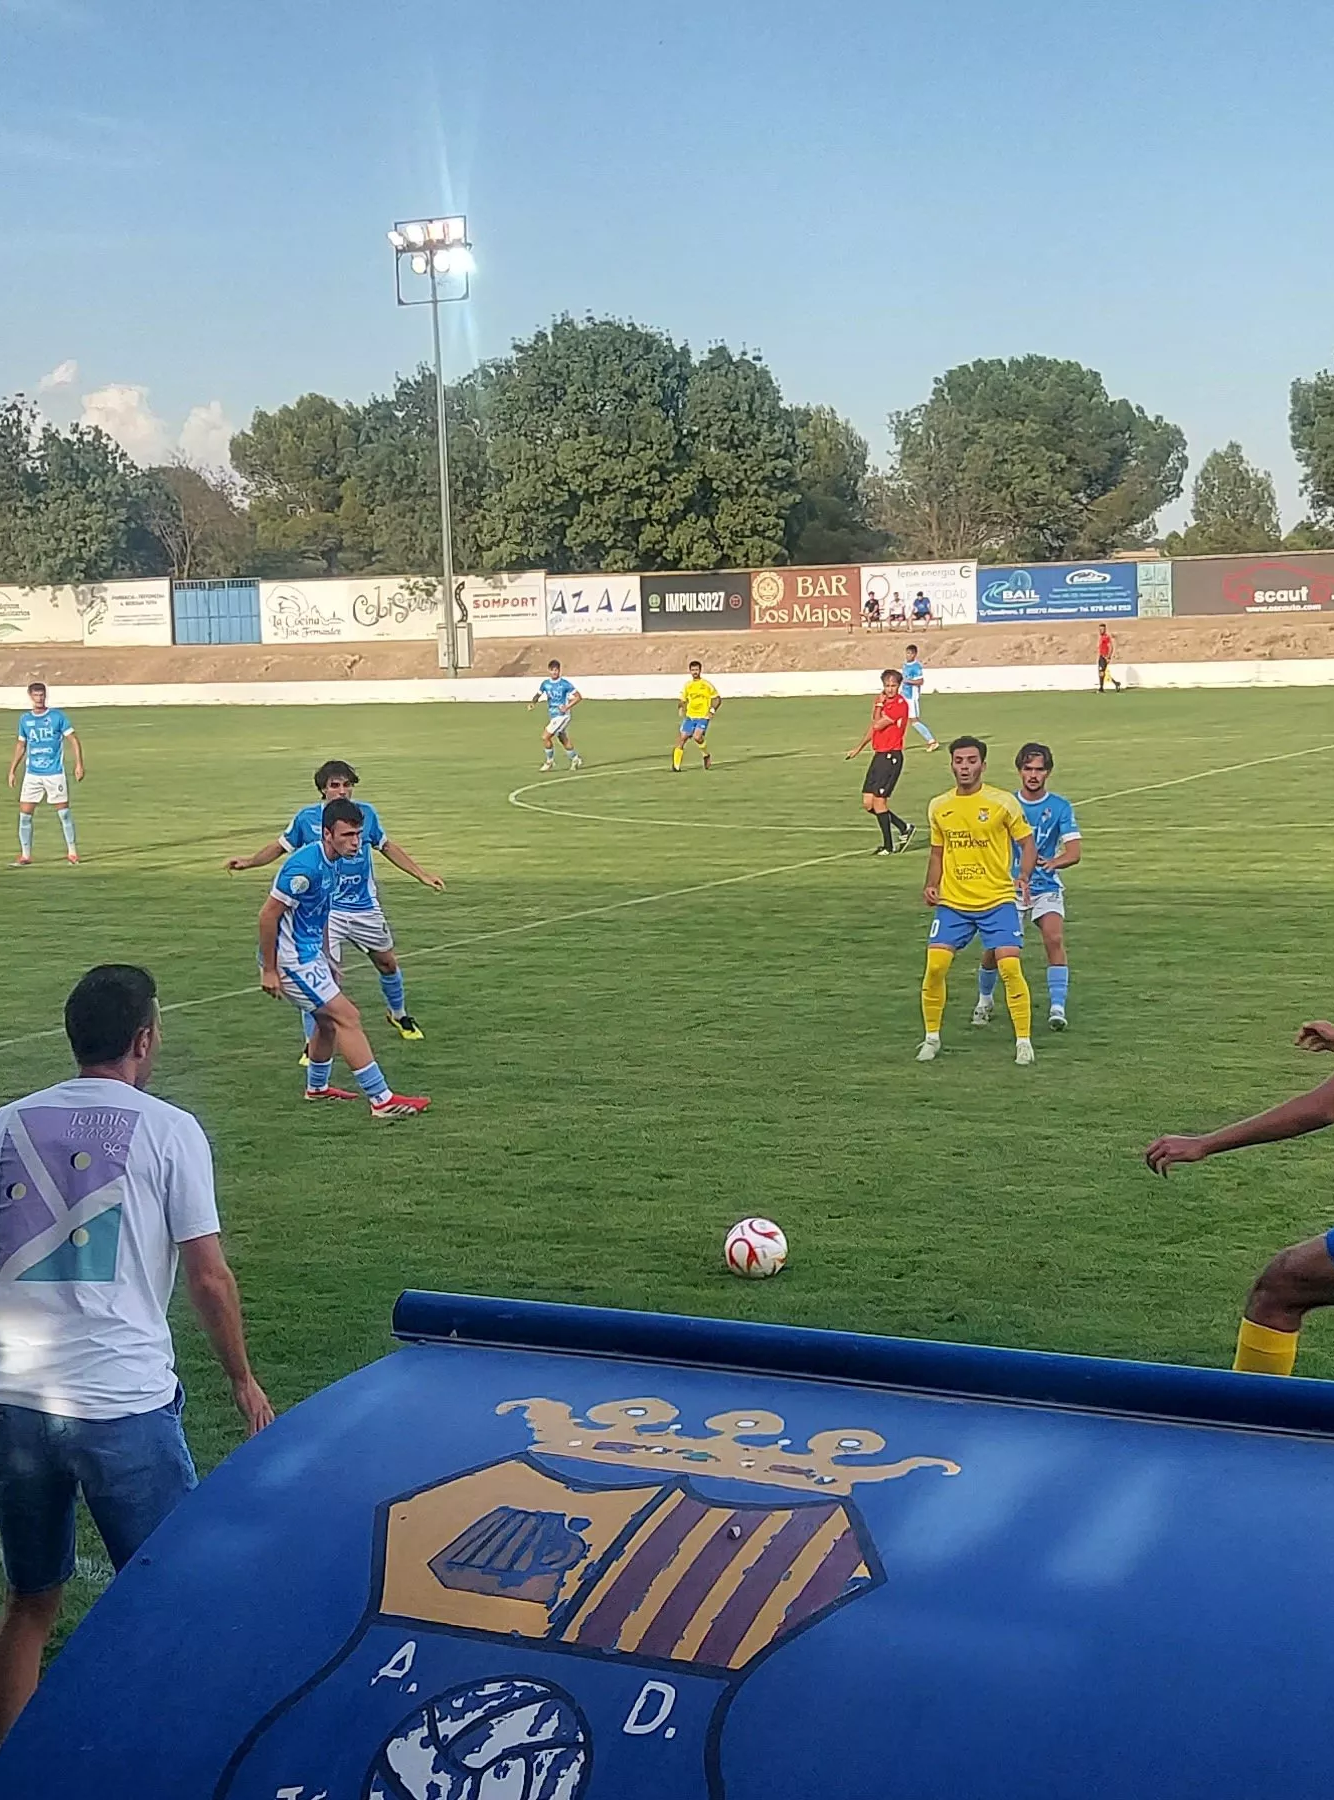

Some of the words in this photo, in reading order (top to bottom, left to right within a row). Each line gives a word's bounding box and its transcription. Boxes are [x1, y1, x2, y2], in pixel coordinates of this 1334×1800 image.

[796, 574, 850, 598] BAR
[1002, 589, 1040, 599] BAIL
[1253, 585, 1309, 603] scaut
[472, 597, 537, 609] SOMPORT
[665, 592, 726, 612] IMPULSO27
[753, 605, 789, 625] Los
[791, 603, 852, 628] Majos
[305, 963, 328, 989] 20
[622, 1680, 677, 1740] D.
